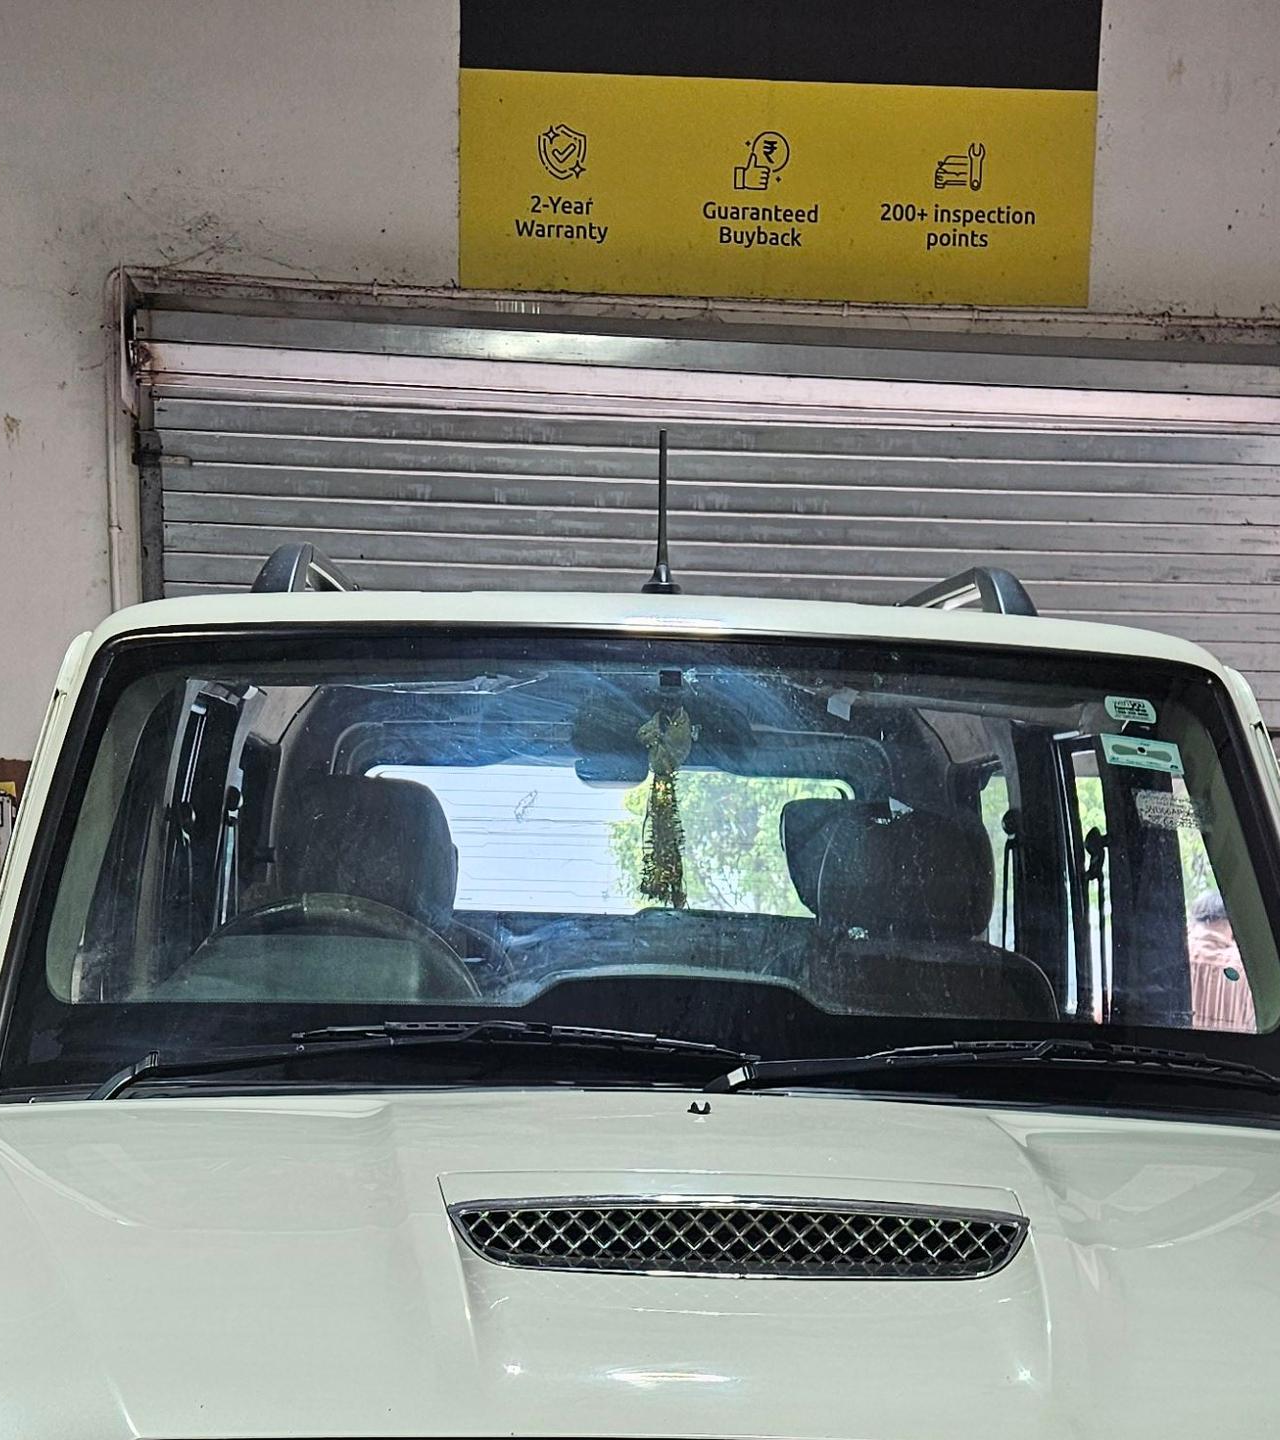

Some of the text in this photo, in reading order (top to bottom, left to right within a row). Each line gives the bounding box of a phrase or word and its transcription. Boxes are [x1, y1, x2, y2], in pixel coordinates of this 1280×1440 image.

[529, 194, 594, 216] 2-Year
[702, 201, 819, 224] Guaranteed
[880, 203, 1036, 228] 200+ inspection
[515, 217, 609, 245] Warranty
[719, 226, 802, 249] Buyback
[926, 228, 989, 250] points
